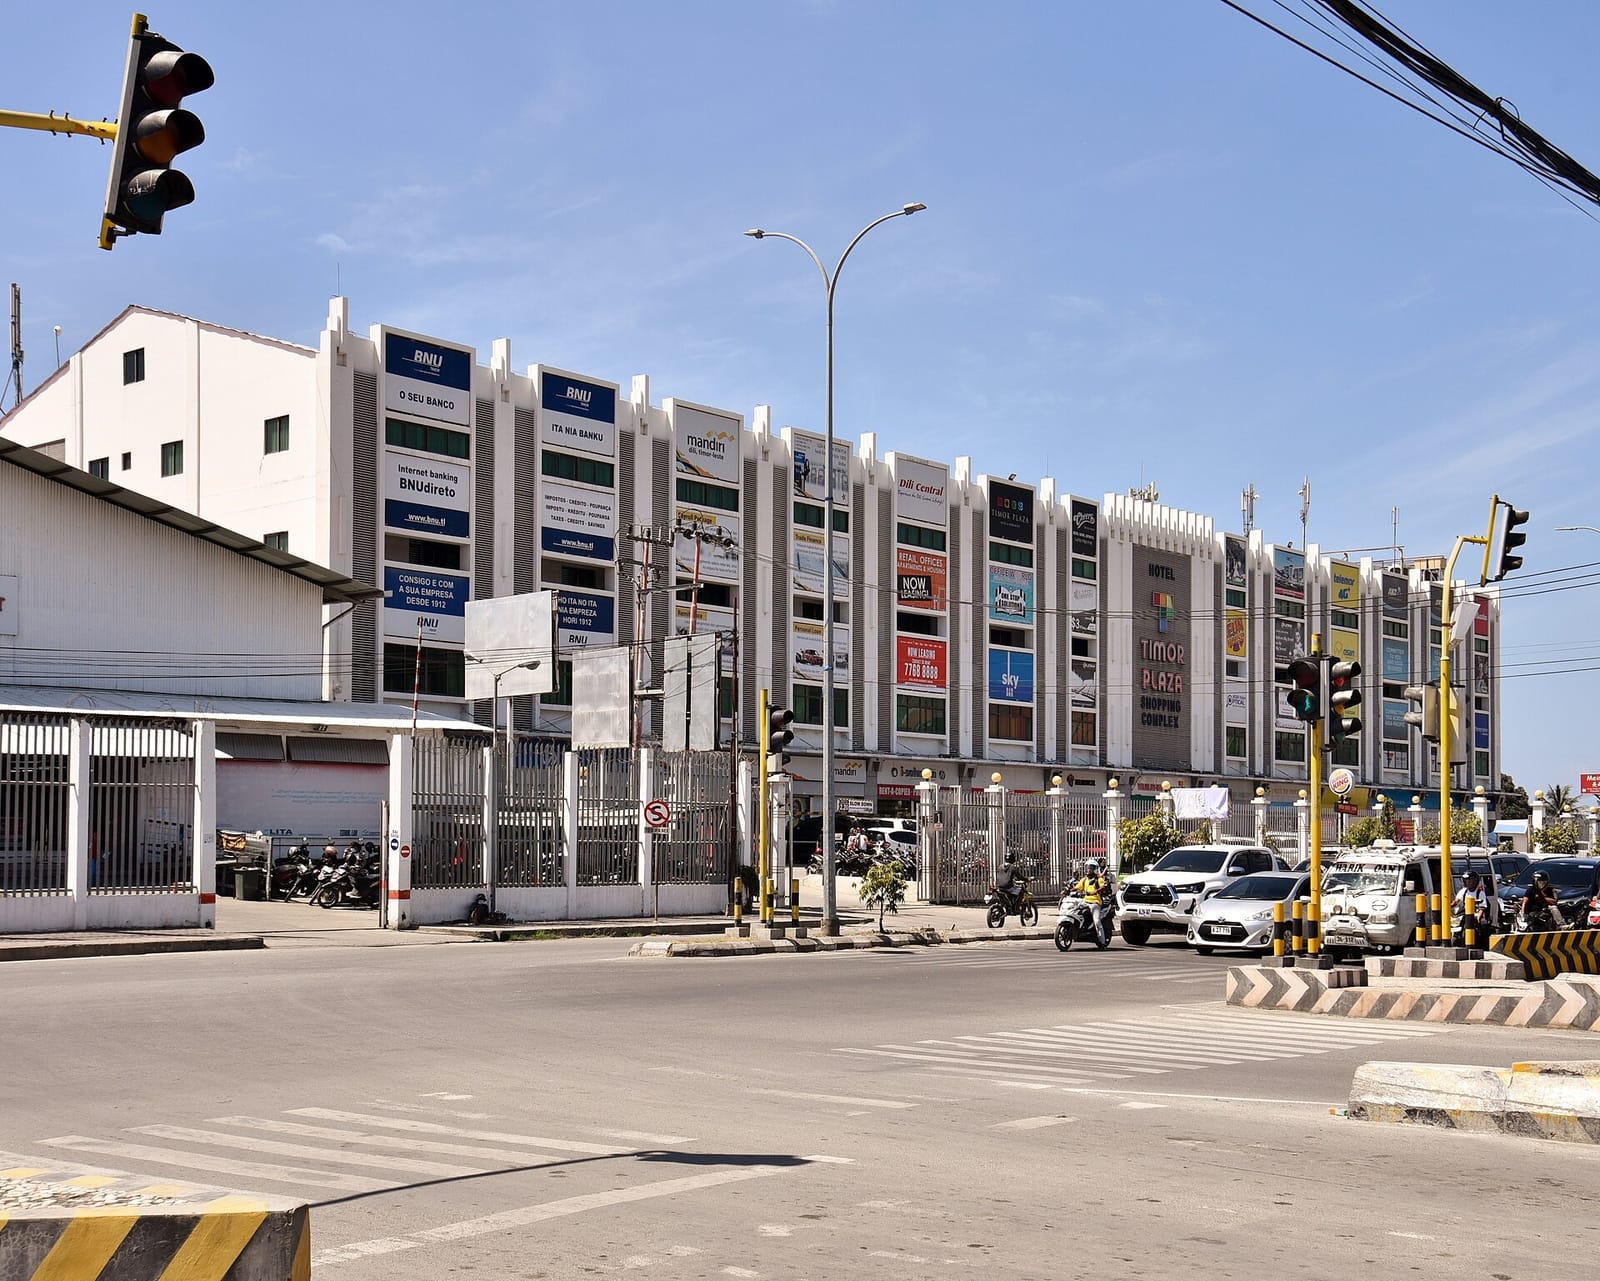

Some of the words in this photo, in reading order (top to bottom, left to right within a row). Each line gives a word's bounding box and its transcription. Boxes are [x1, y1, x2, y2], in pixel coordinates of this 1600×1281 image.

[414, 350, 443, 367] BNU
[399, 390, 406, 400] O
[408, 392, 424, 403] SEU
[426, 396, 455, 410] BANCO
[566, 386, 591, 402] BNU
[551, 423, 563, 434] ITA
[565, 426, 578, 437] NIA
[579, 429, 604, 442] BANKU
[687, 434, 725, 453] mandiri
[398, 464, 428, 477] Internet
[429, 470, 459, 484] banking
[399, 477, 456, 498] BNUdireto
[899, 479, 915, 489] Dili
[915, 483, 944, 496] Central
[544, 494, 567, 504] IMPOSTOS
[919, 556, 943, 567] OFFICES
[1148, 563, 1175, 581] HOTEL
[398, 574, 431, 586] CONSIGO
[432, 579, 437, 587] E
[438, 580, 454, 588] COM
[902, 577, 926, 590] NOW
[398, 585, 404, 593] A
[405, 586, 420, 595] SUA
[421, 588, 454, 599] EMPRESA
[406, 596, 430, 607] DESDE
[431, 600, 446, 608] 1912
[567, 597, 578, 606] ITA
[578, 598, 587, 606] NO
[587, 600, 598, 608] ITA
[568, 607, 597, 617] EMPREZA
[562, 616, 577, 624] HORI
[579, 618, 592, 626] 1912
[568, 634, 588, 644] BNU
[1141, 640, 1185, 664] TIMOR
[1001, 673, 1019, 689] sky
[1142, 668, 1184, 693] PLAZA
[1140, 695, 1181, 713] SHOPPING
[1141, 712, 1180, 729] COMPLEX
